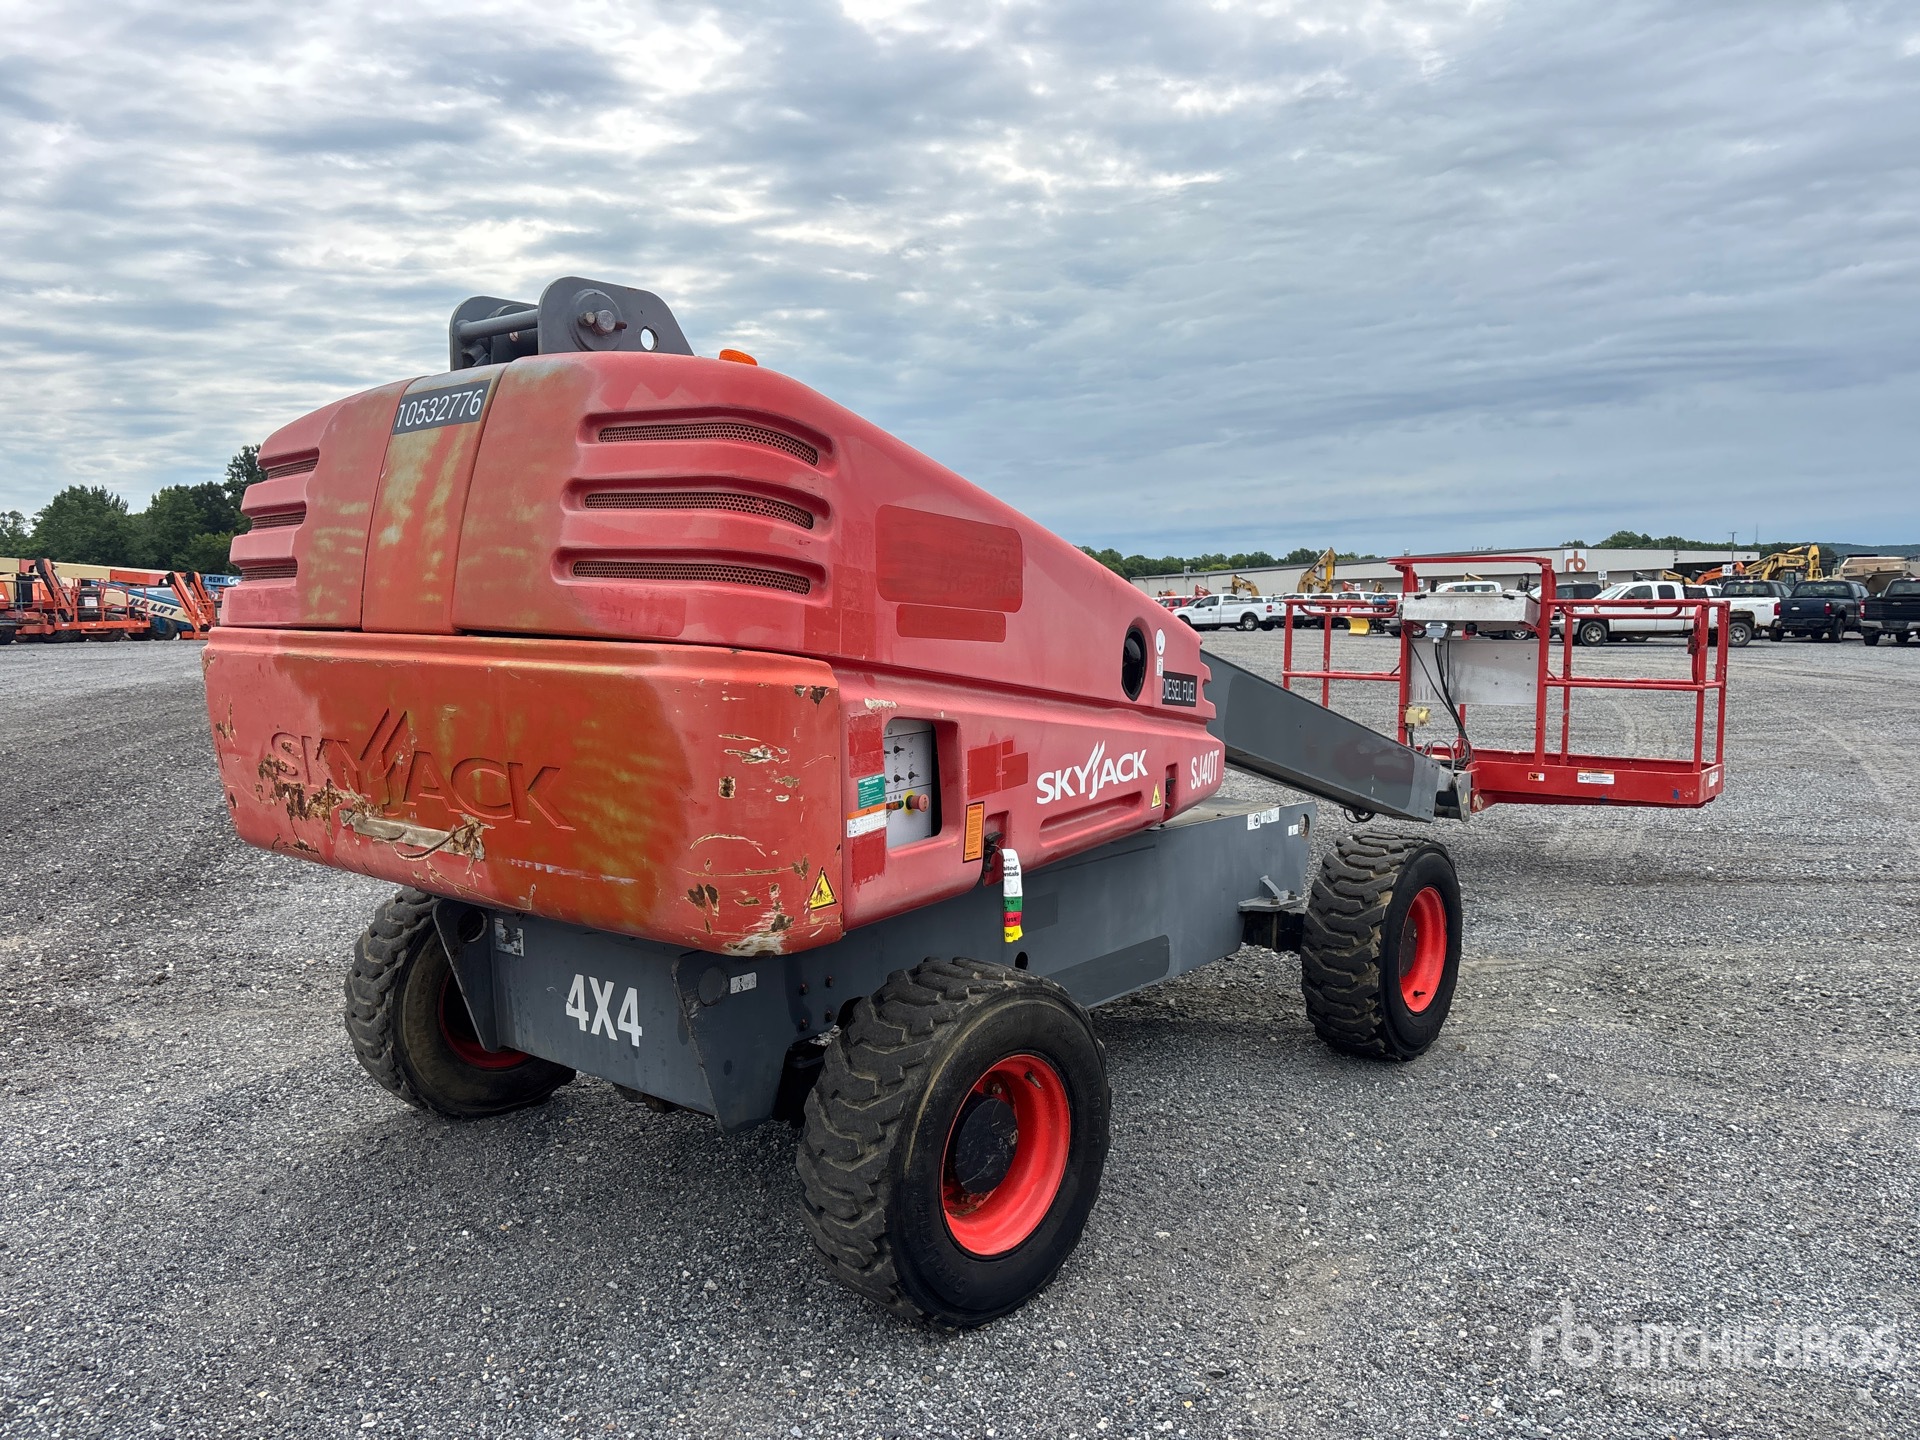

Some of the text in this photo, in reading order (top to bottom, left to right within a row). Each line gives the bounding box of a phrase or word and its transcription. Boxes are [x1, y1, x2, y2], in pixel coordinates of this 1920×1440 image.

[397, 389, 484, 428] 10532776
[1565, 550, 1586, 572] rb
[151, 603, 177, 615] LIFT
[1162, 678, 1196, 702] DIESEL FUEL
[270, 708, 577, 831] SKYJACK
[1036, 740, 1149, 804] SKYJACK
[1190, 749, 1221, 790] SJ40T
[565, 973, 643, 1048] 4X4
